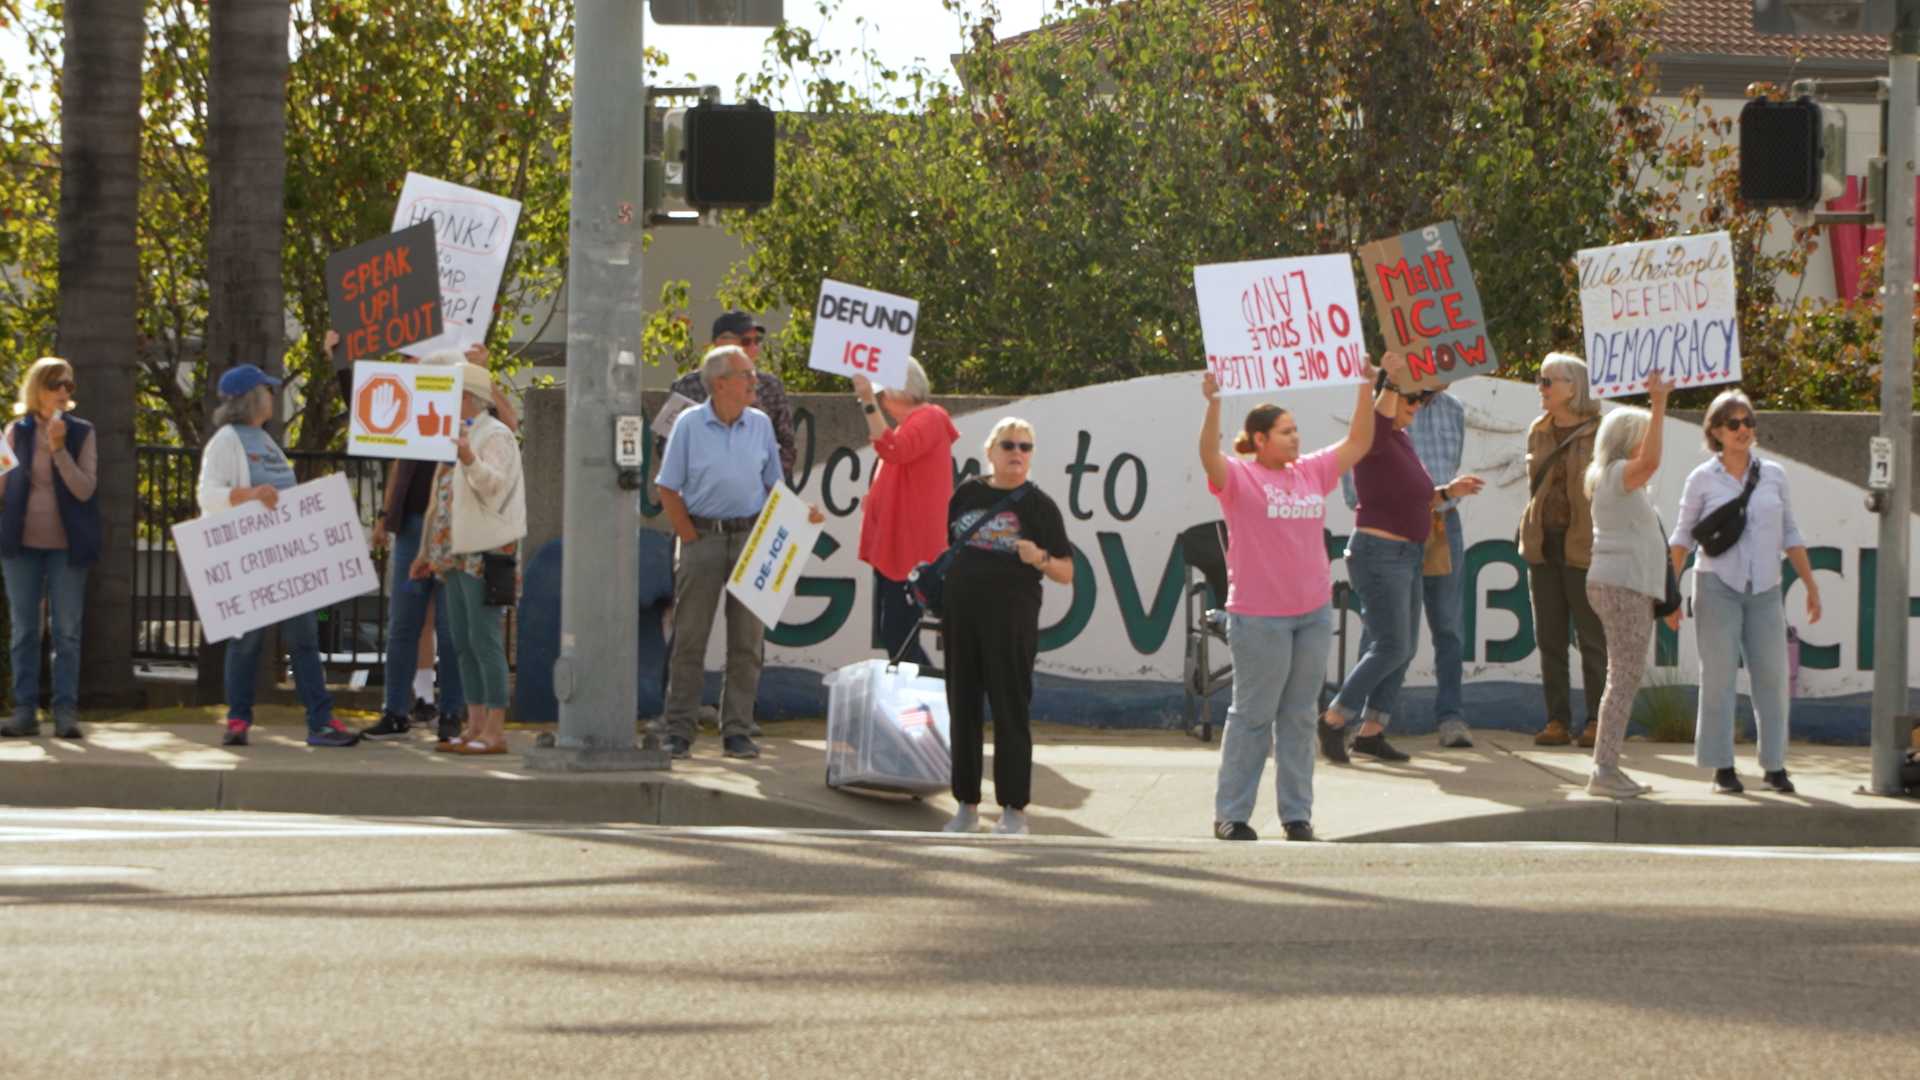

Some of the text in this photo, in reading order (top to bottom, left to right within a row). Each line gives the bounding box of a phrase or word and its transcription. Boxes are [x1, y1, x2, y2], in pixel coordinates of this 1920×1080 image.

[341, 247, 412, 300] SPEAK
[1580, 241, 1730, 290] We the People
[360, 285, 399, 325] UP!
[820, 294, 913, 336] DEFUND
[1241, 270, 1312, 327] LAND
[1611, 280, 1710, 320] DEFEND
[346, 302, 435, 361] ICE OUT
[1247, 318, 1301, 351] STOLE
[1592, 318, 1736, 386] DEMOCRACY
[843, 340, 882, 373] ICE
[1272, 355, 1291, 387] IS
[1294, 348, 1330, 381] ONE
[1335, 343, 1364, 379] NO
[1406, 336, 1487, 381] NOW
[1065, 430, 1148, 522] to
[203, 493, 326, 548] IMMIGRANTS ARE
[1267, 505, 1322, 519] BODIES
[204, 521, 354, 586] NOT CRIMINALS BUT
[216, 557, 364, 620] THE PRESIDENT IS!
